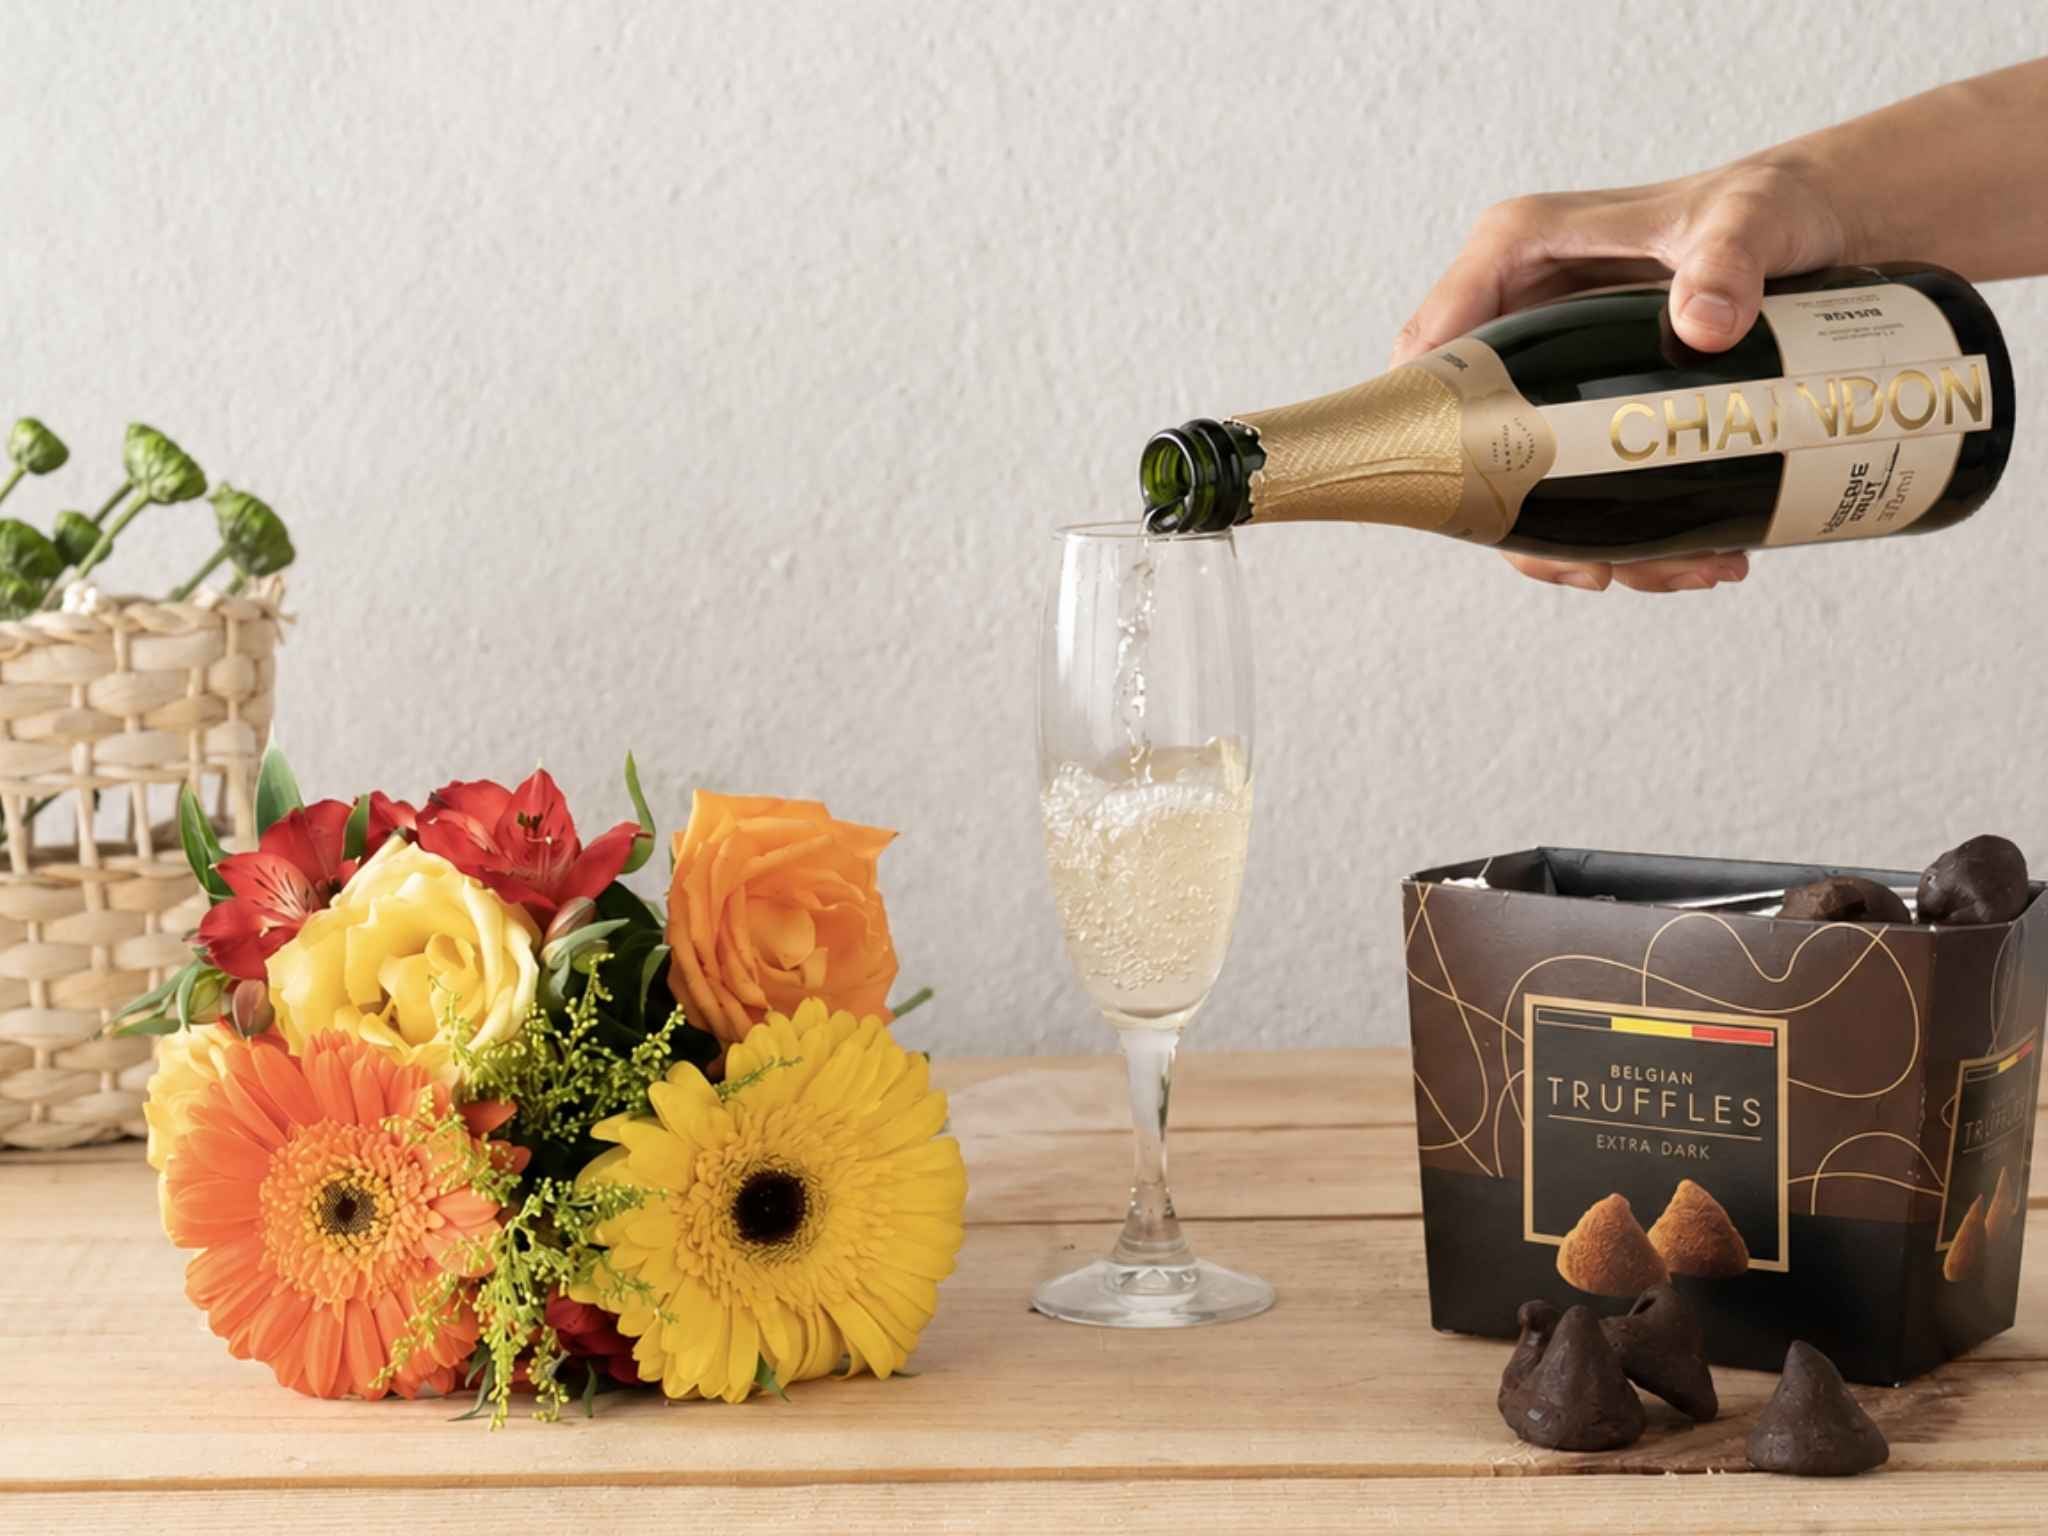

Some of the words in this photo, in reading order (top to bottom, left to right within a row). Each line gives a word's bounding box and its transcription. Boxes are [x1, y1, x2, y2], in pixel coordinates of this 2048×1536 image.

[1608, 362, 1986, 463] CHANDON
[1610, 1064, 1694, 1086] BELGIAN
[1546, 1075, 1763, 1128] TRUFFLES
[1595, 1133, 1653, 1154] EXTRA
[1661, 1138, 1711, 1160] DARK
